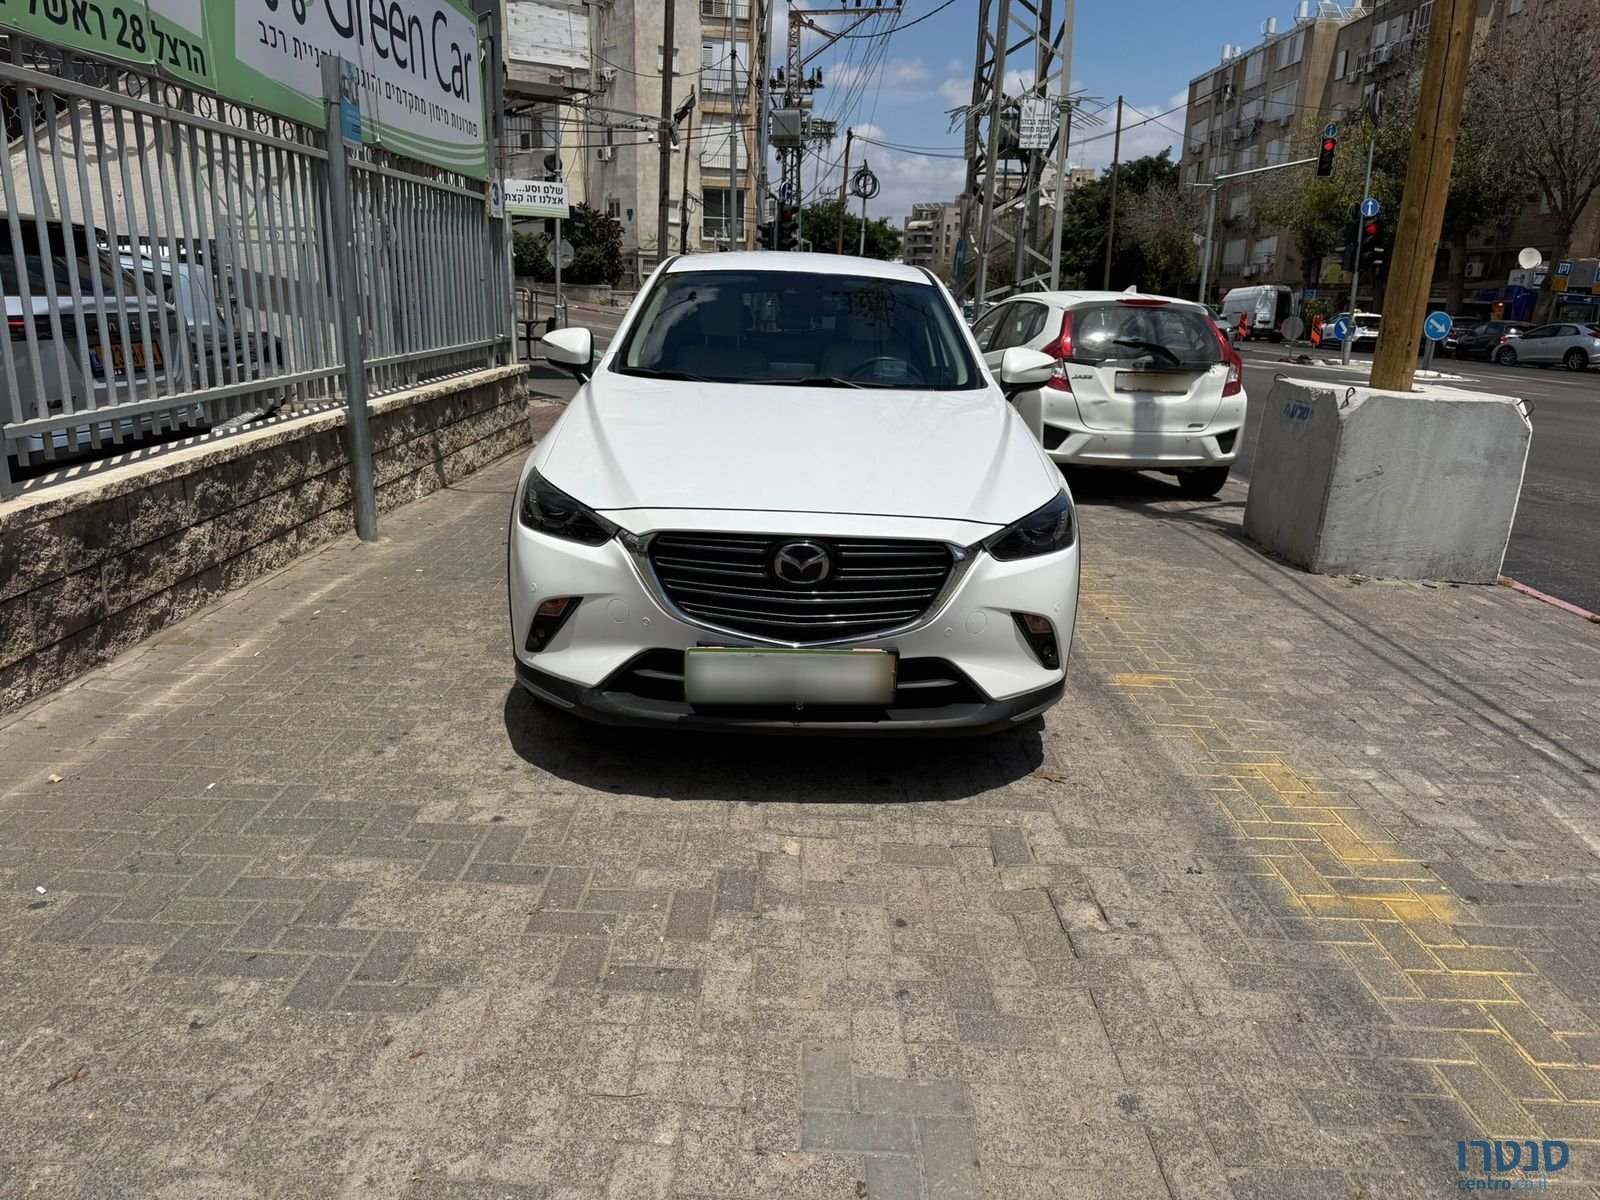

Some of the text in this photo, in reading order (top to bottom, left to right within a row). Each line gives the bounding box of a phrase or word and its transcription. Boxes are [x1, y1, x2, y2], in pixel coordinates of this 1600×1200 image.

[112, 7, 147, 54] 28
[258, 20, 287, 54] רכב
[151, 19, 207, 76] הרצל
[293, 37, 332, 68] ניית
[432, 10, 472, 103] Car
[385, 81, 427, 115] מתקדמים
[428, 102, 449, 125] מימון
[451, 112, 478, 138] פתרונות
[504, 193, 564, 205] אצלנו זה קצת
[516, 184, 564, 195] שלם וסע...
